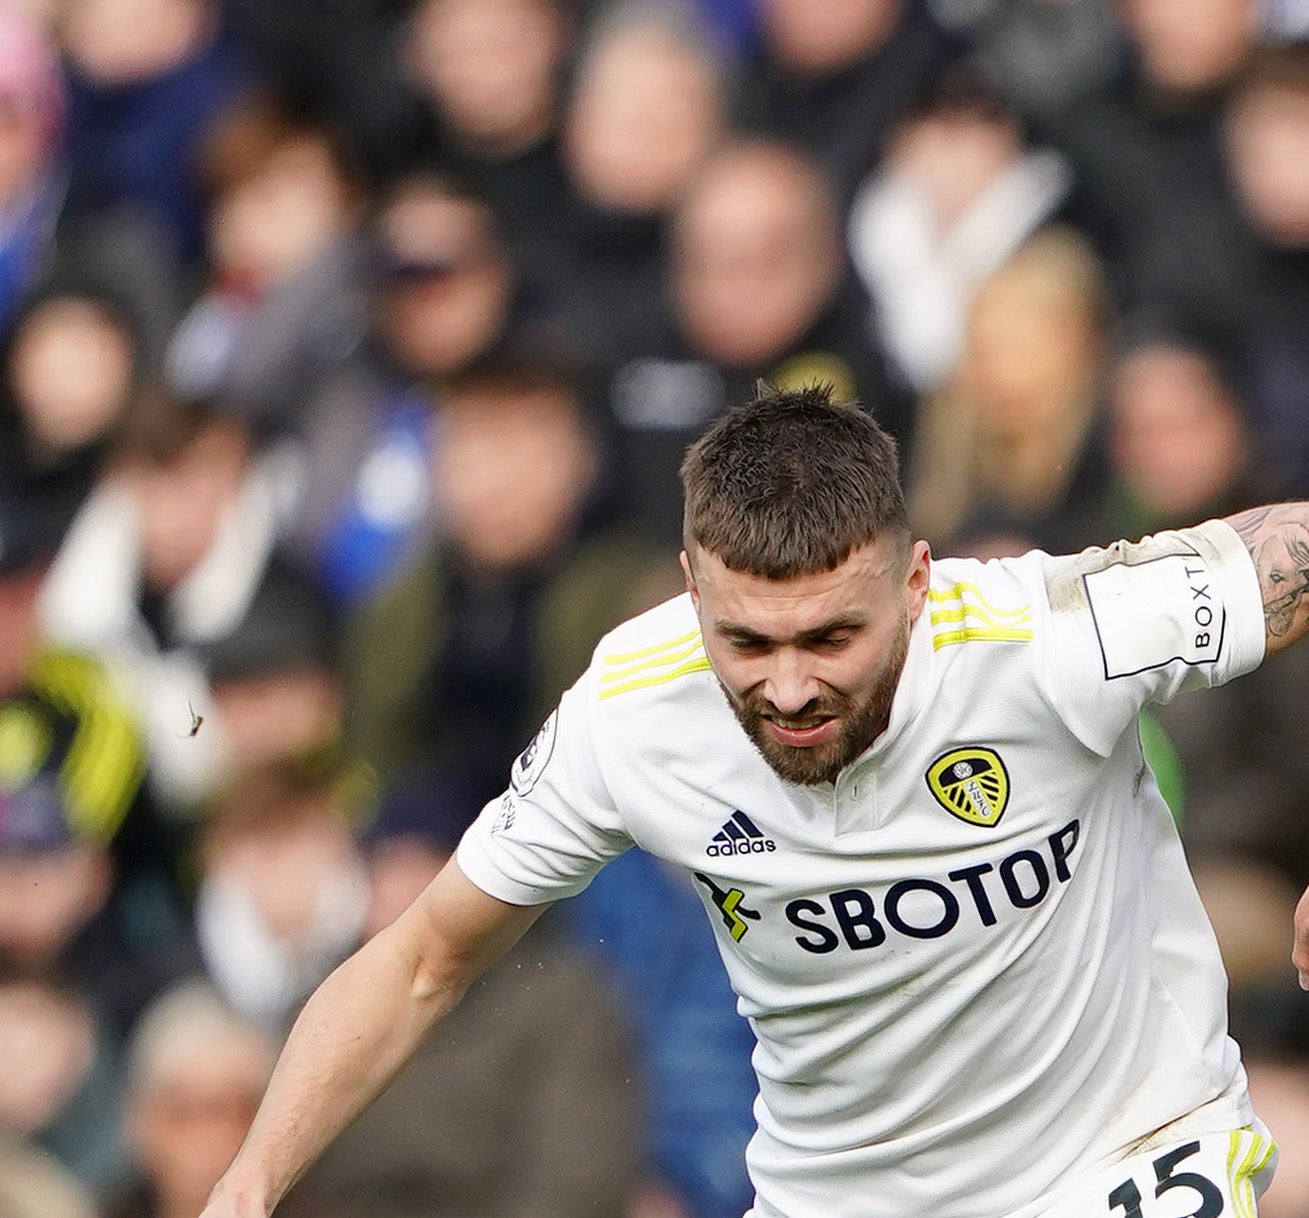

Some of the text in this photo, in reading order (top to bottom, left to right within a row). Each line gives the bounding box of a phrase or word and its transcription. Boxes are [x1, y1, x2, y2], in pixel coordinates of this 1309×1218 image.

[1184, 565, 1213, 649] BOXT
[706, 836, 777, 858] adidas
[784, 818, 1081, 955] SBOTOP
